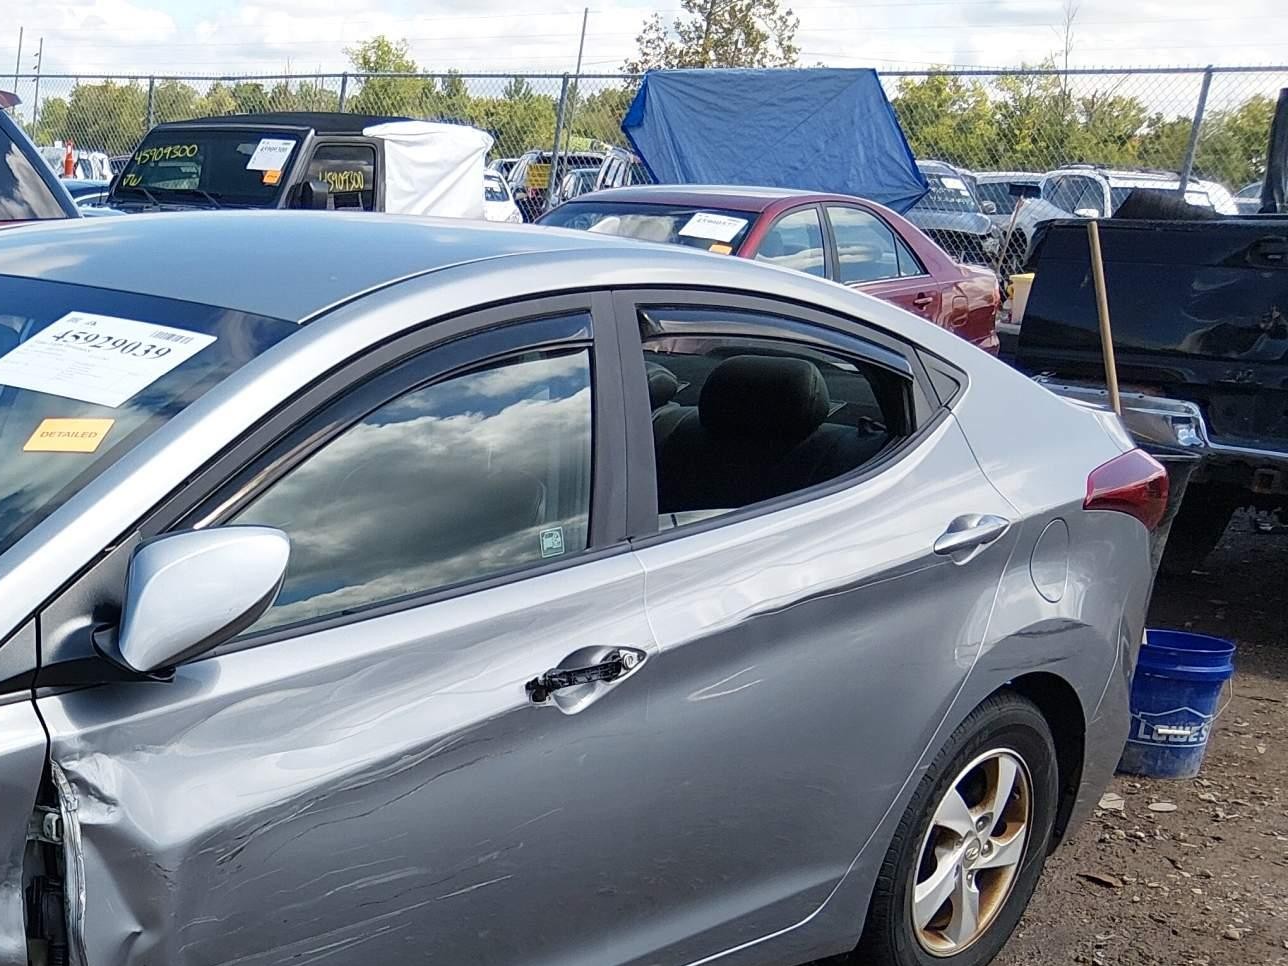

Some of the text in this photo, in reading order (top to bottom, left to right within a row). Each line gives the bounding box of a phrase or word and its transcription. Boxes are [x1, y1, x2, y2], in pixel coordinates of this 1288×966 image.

[134, 143, 199, 166] 45909300
[51, 329, 173, 360] 45929039
[39, 430, 98, 439] DETAILED
